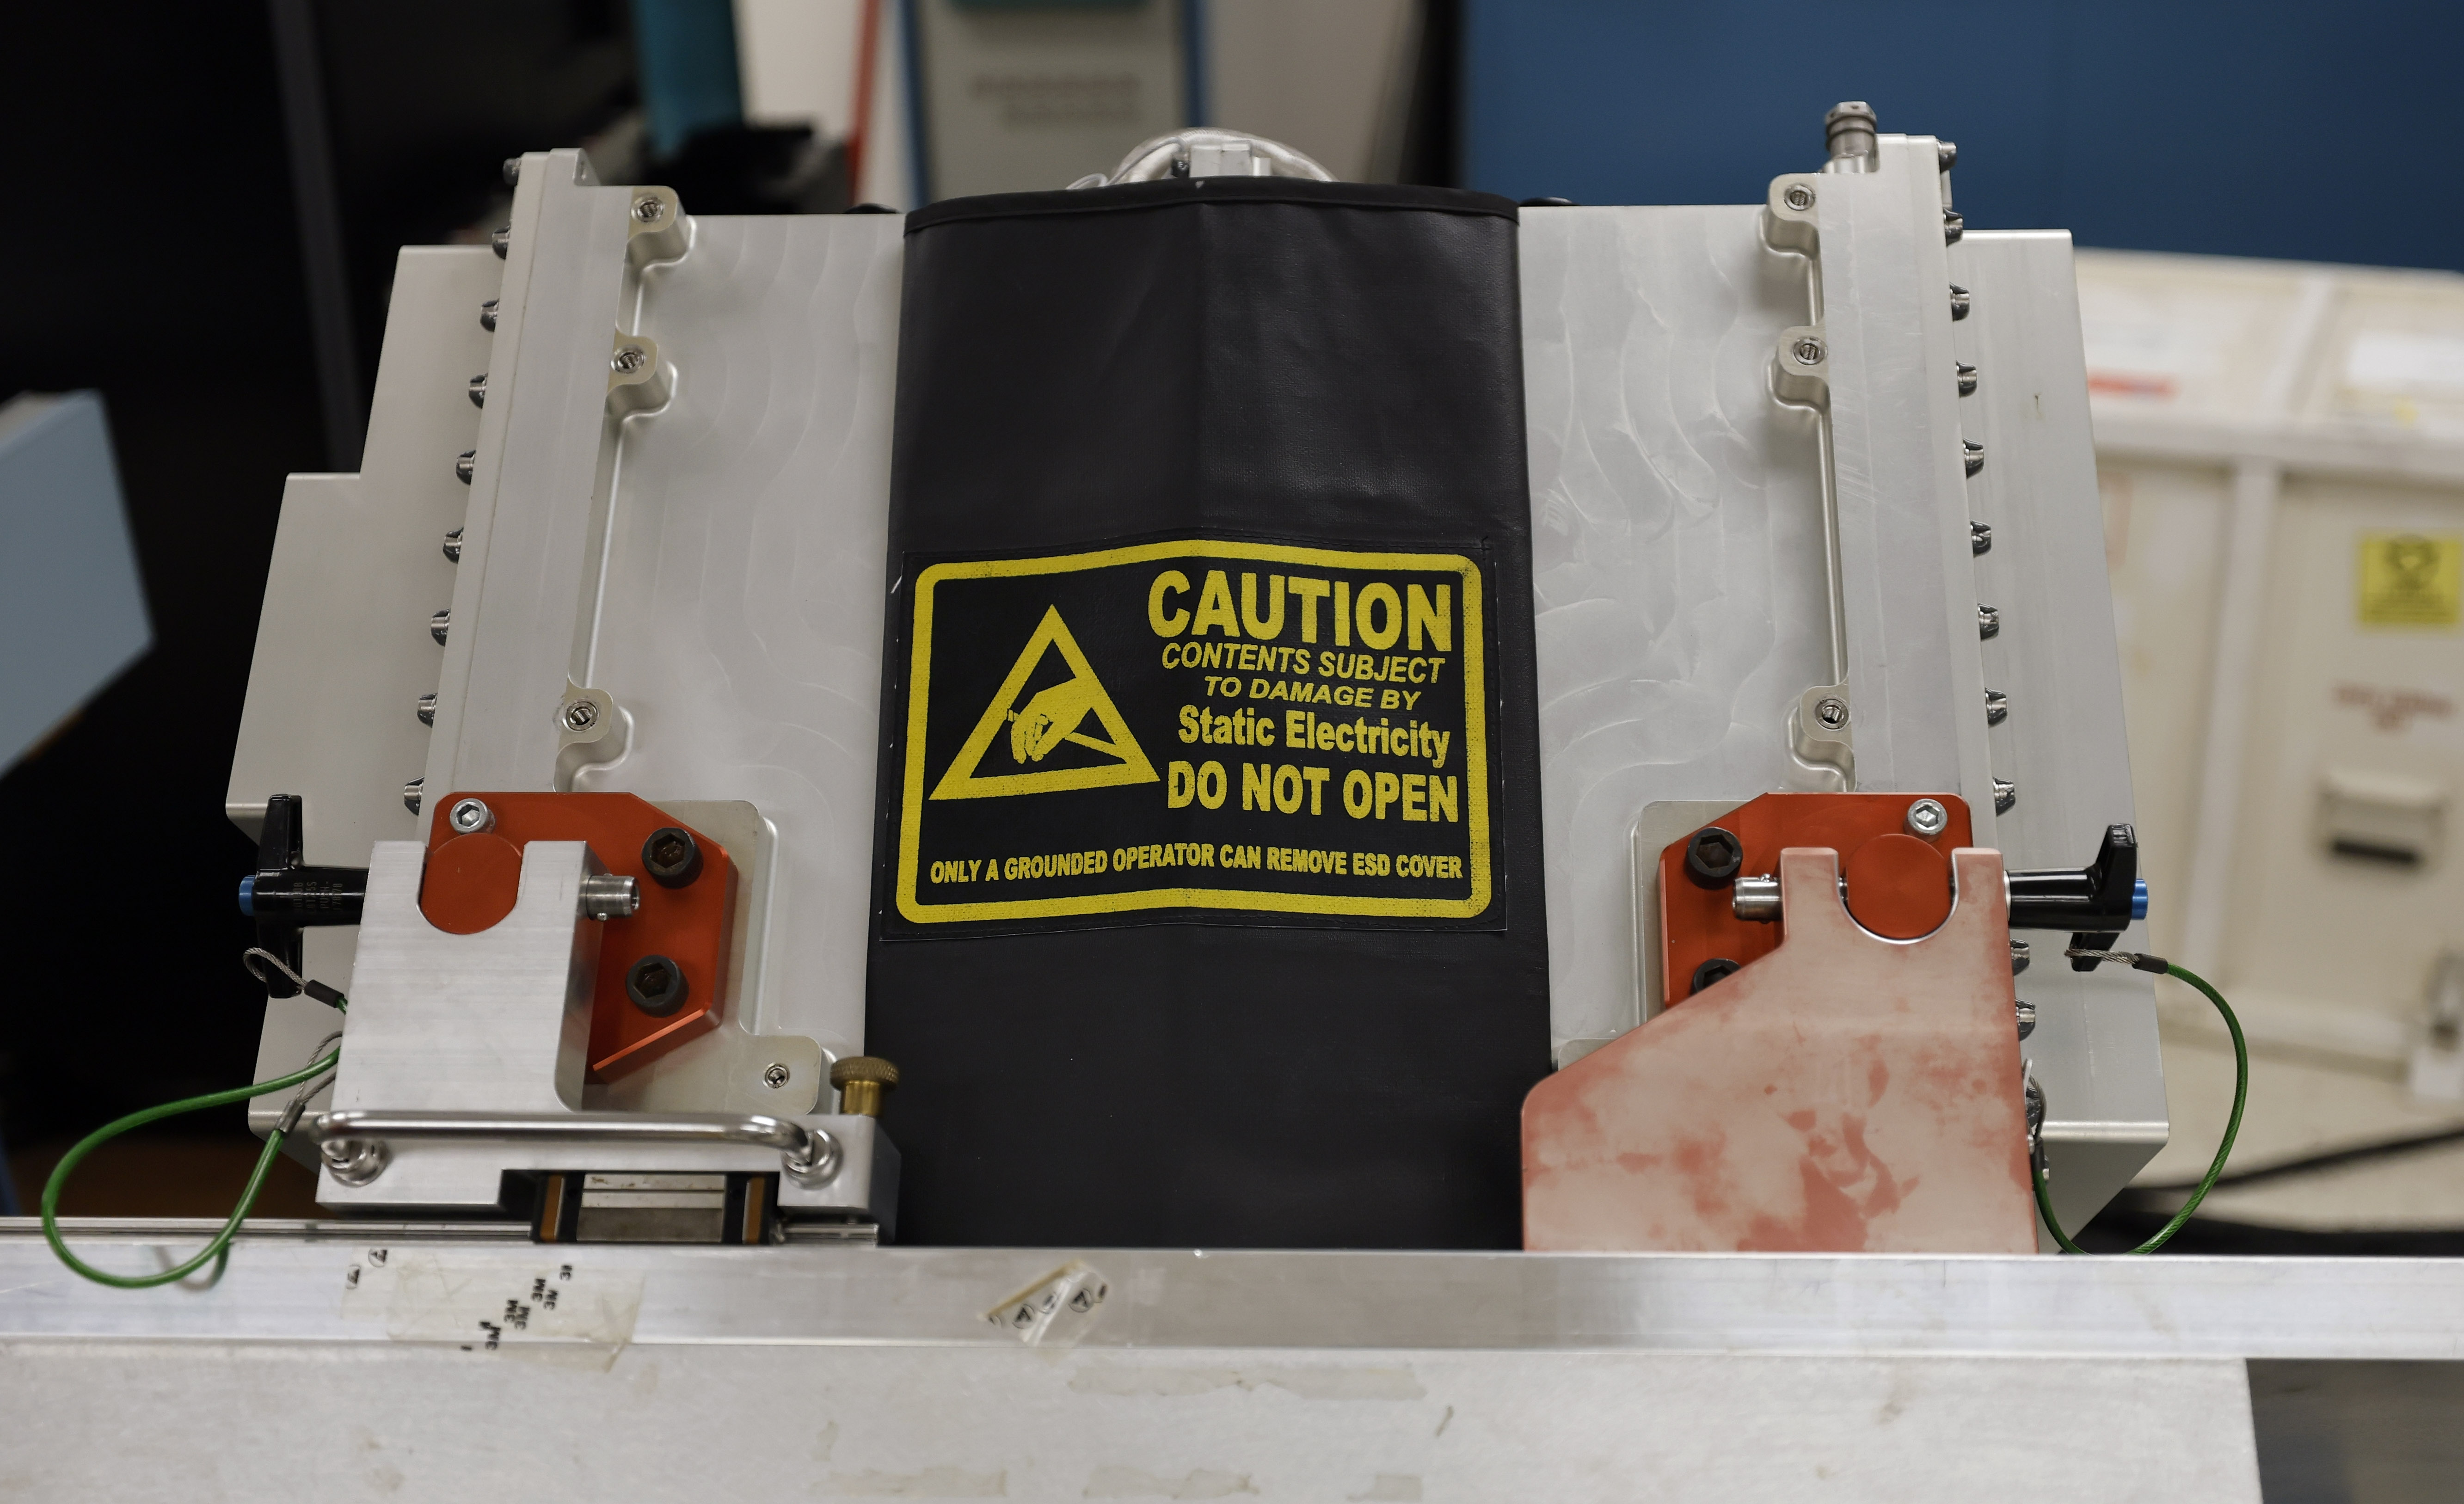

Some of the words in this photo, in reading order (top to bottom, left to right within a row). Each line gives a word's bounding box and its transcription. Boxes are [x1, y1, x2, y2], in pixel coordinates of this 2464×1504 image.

[1148, 570, 1451, 652] CAUTION
[1162, 642, 1311, 675] CONTENTS
[1318, 651, 1445, 684] SUBJECT
[1204, 675, 1242, 698] TO
[1249, 679, 1374, 708] DAMAGE
[1381, 689, 1421, 710] BY
[1179, 705, 1275, 746] Static
[1286, 710, 1450, 768] Electricity
[1167, 760, 1228, 810] DO
[1242, 762, 1330, 816] NOT
[1343, 769, 1458, 823] OPEN
[930, 859, 982, 884] ONLY
[985, 859, 999, 881] A
[1004, 850, 1108, 880] GROUNDED
[1112, 842, 1215, 872] OPERATOR
[1220, 844, 1261, 869] CAN
[1267, 847, 1347, 875] REMOVE
[1352, 853, 1391, 877] ESD
[1396, 854, 1463, 878] COVER
[531, 1278, 546, 1302] 3M
[504, 1300, 518, 1323] 3M
[515, 1307, 530, 1330] 3M
[485, 1326, 501, 1350] 3M
